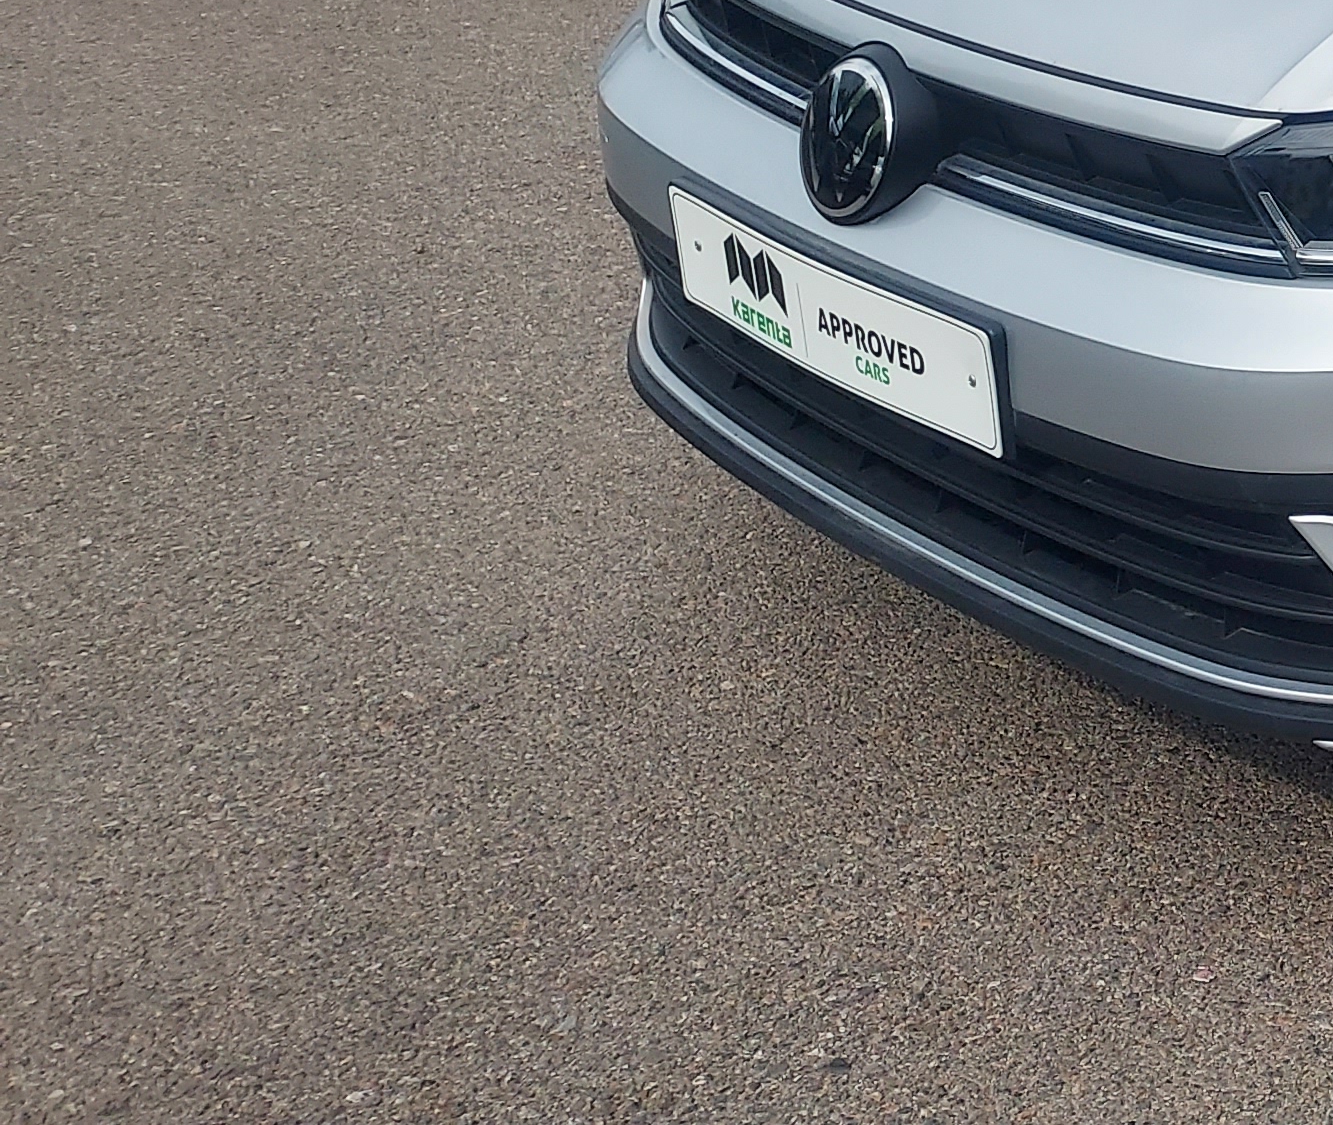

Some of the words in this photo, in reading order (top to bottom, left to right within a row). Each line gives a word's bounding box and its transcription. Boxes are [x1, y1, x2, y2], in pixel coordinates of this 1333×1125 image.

[731, 295, 793, 349] Karenta
[818, 307, 925, 376] APPROVED
[855, 356, 891, 386] CARS
